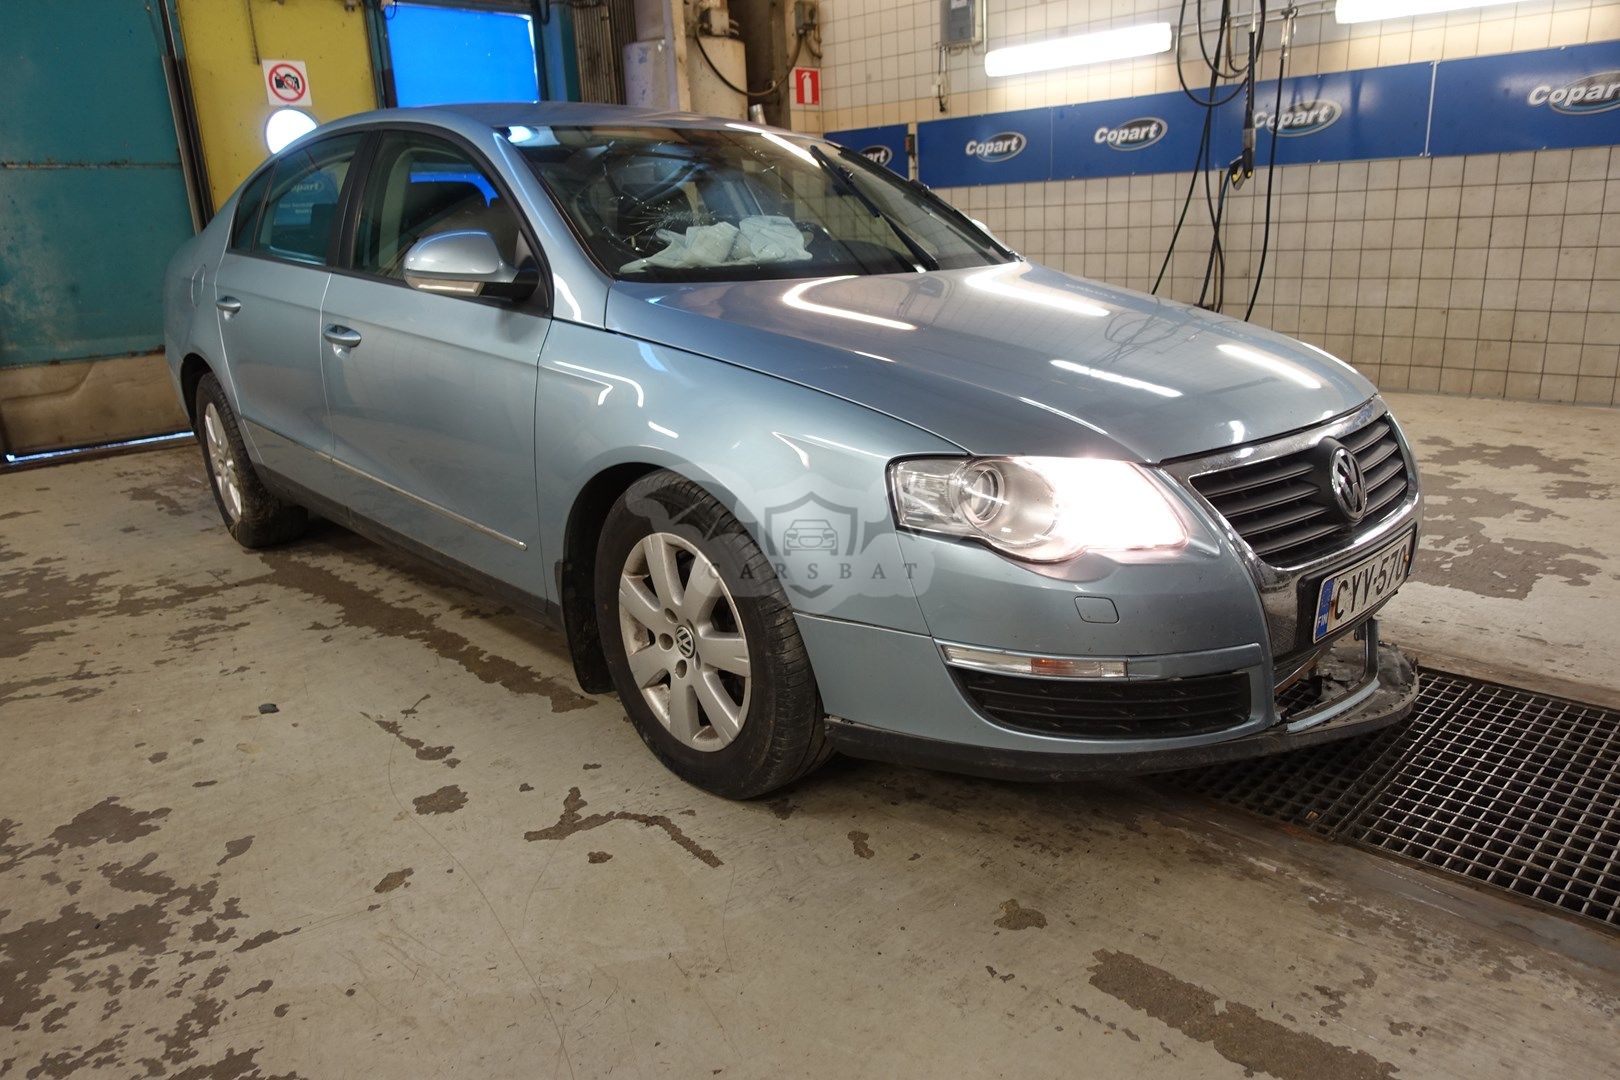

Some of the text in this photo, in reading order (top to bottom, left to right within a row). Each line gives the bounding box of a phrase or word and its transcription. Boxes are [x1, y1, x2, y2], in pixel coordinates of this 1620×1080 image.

[1528, 85, 1620, 107] Copar
[1254, 105, 1329, 130] Copart
[1094, 123, 1159, 146] Copart
[965, 137, 1019, 156] Copart
[1334, 544, 1407, 620] CYV-570
[1317, 611, 1329, 627] FIN
